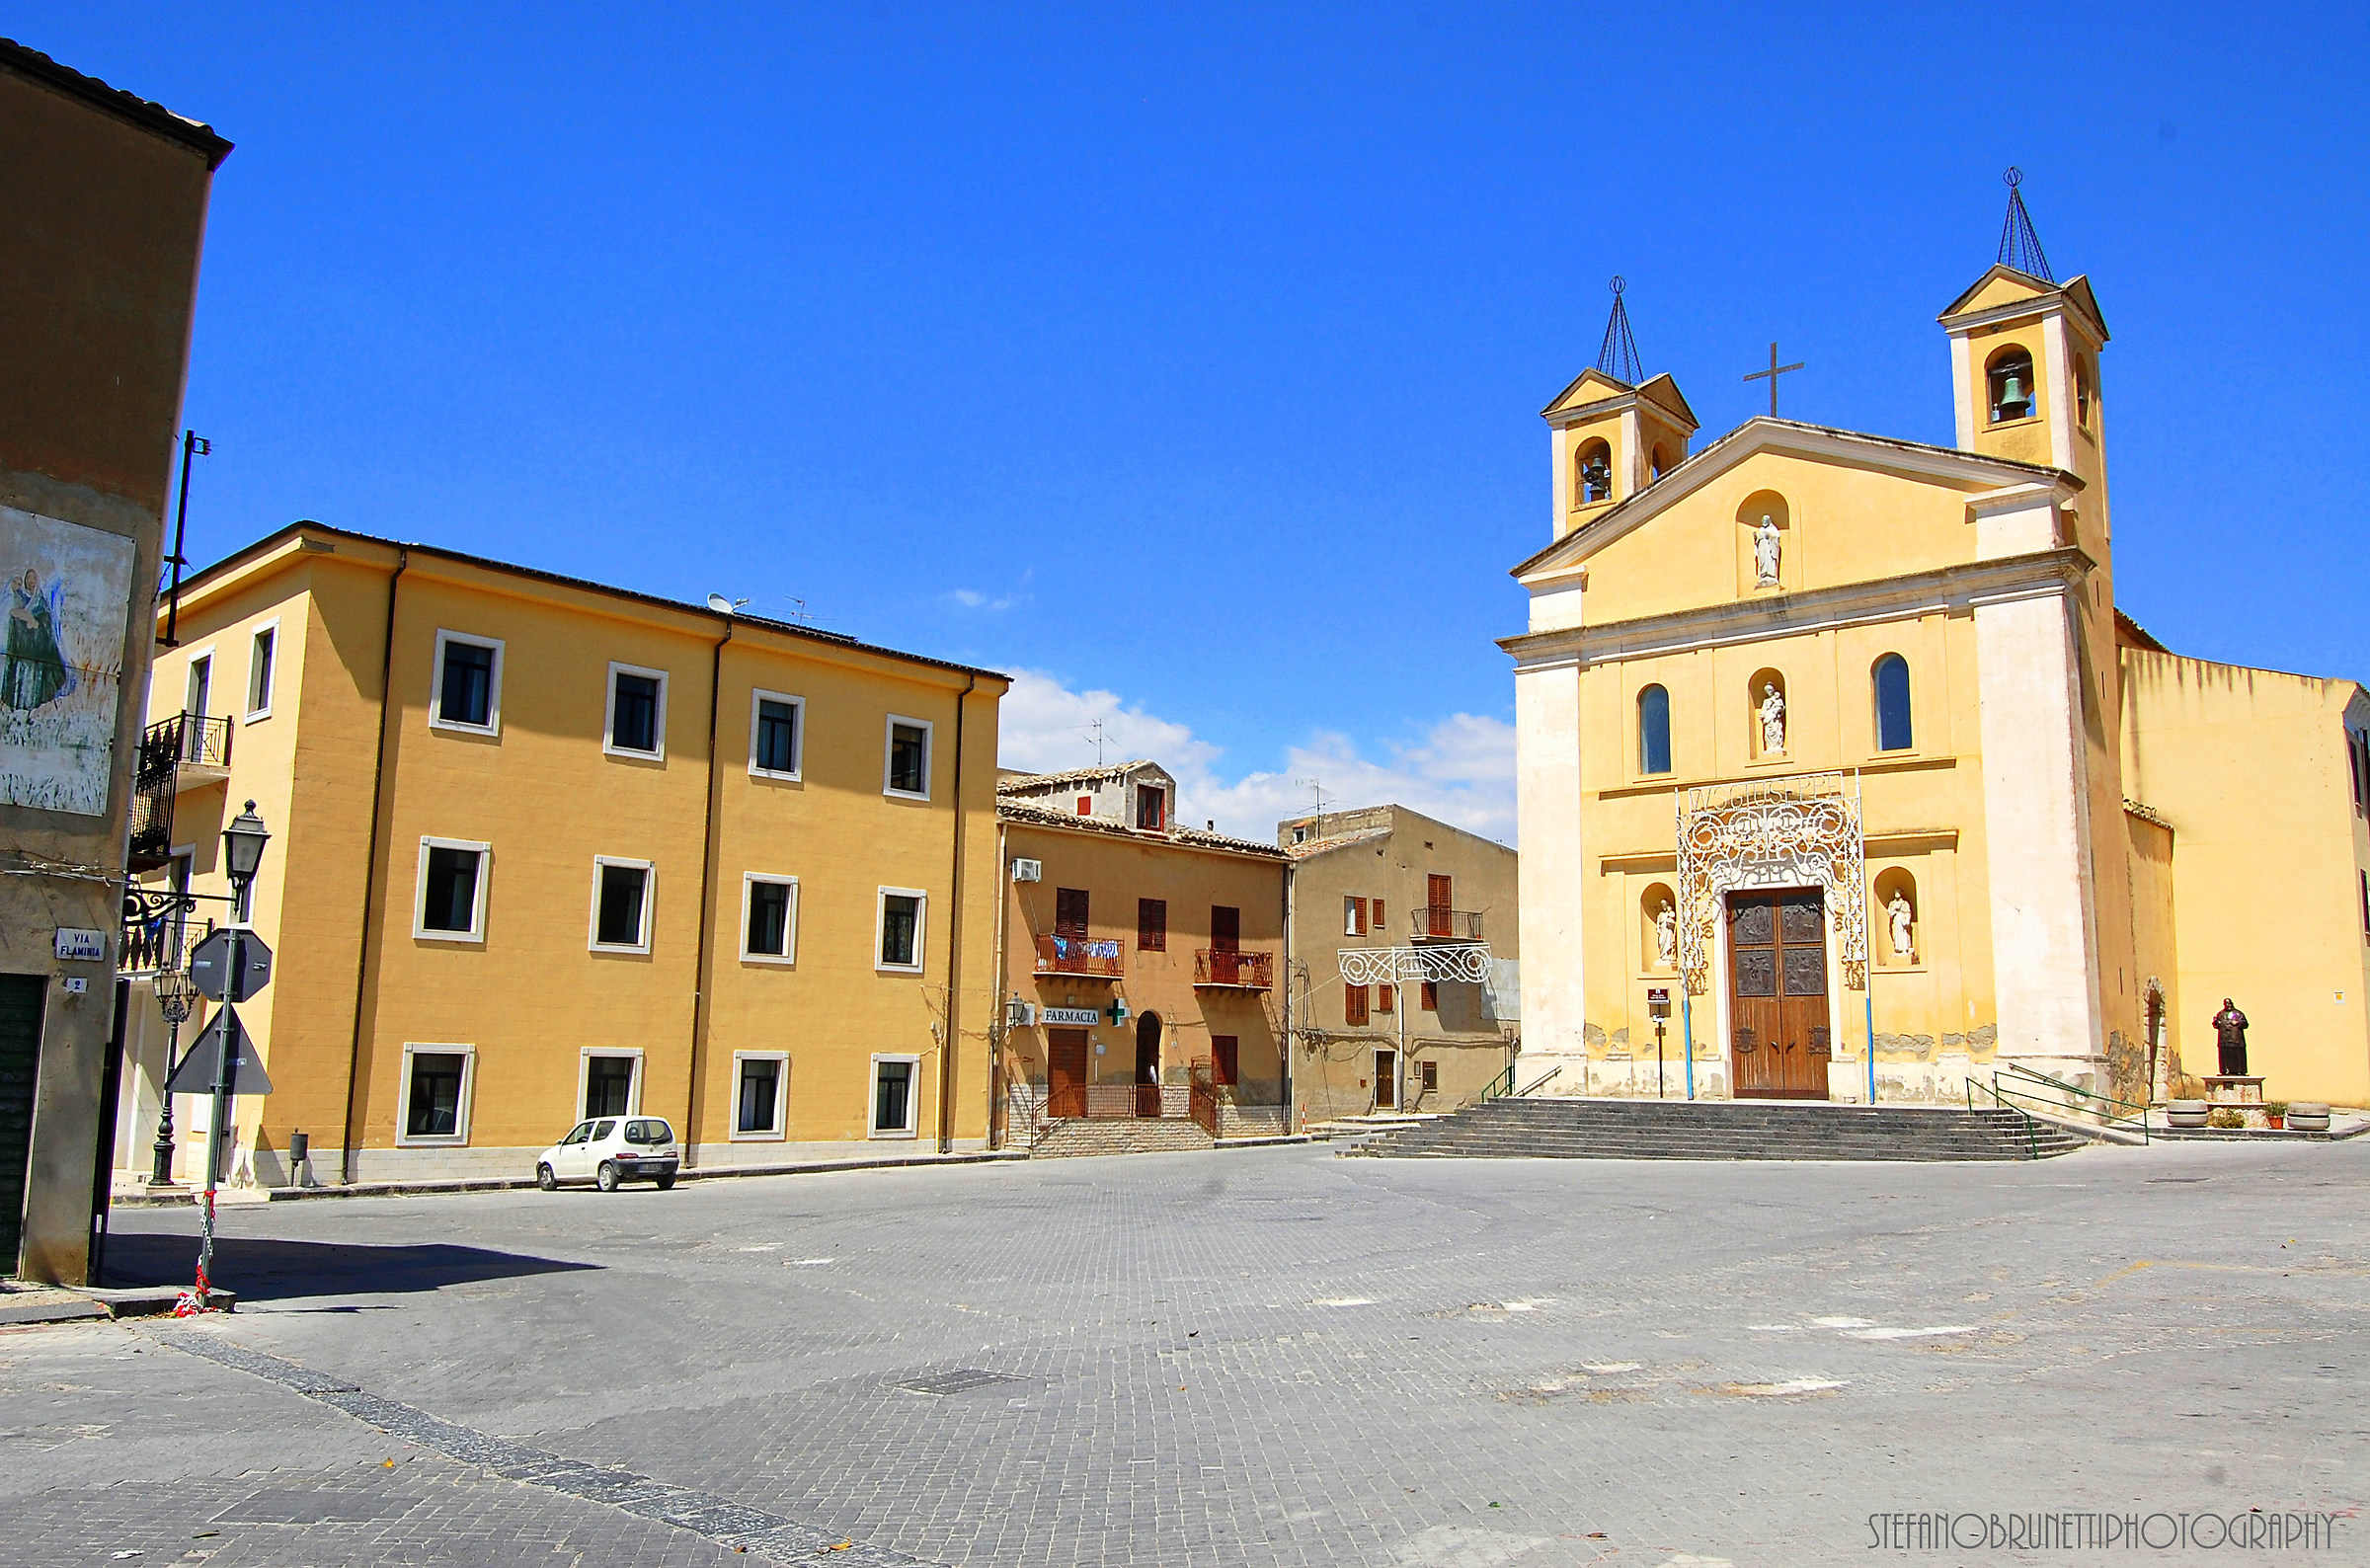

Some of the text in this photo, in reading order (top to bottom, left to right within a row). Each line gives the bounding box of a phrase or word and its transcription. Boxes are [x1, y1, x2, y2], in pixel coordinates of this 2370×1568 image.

[74, 933, 90, 944] VIA
[60, 945, 101, 957] FLAMINIA
[74, 980, 81, 990] 2
[1045, 1009, 1098, 1023] FARMACIA
